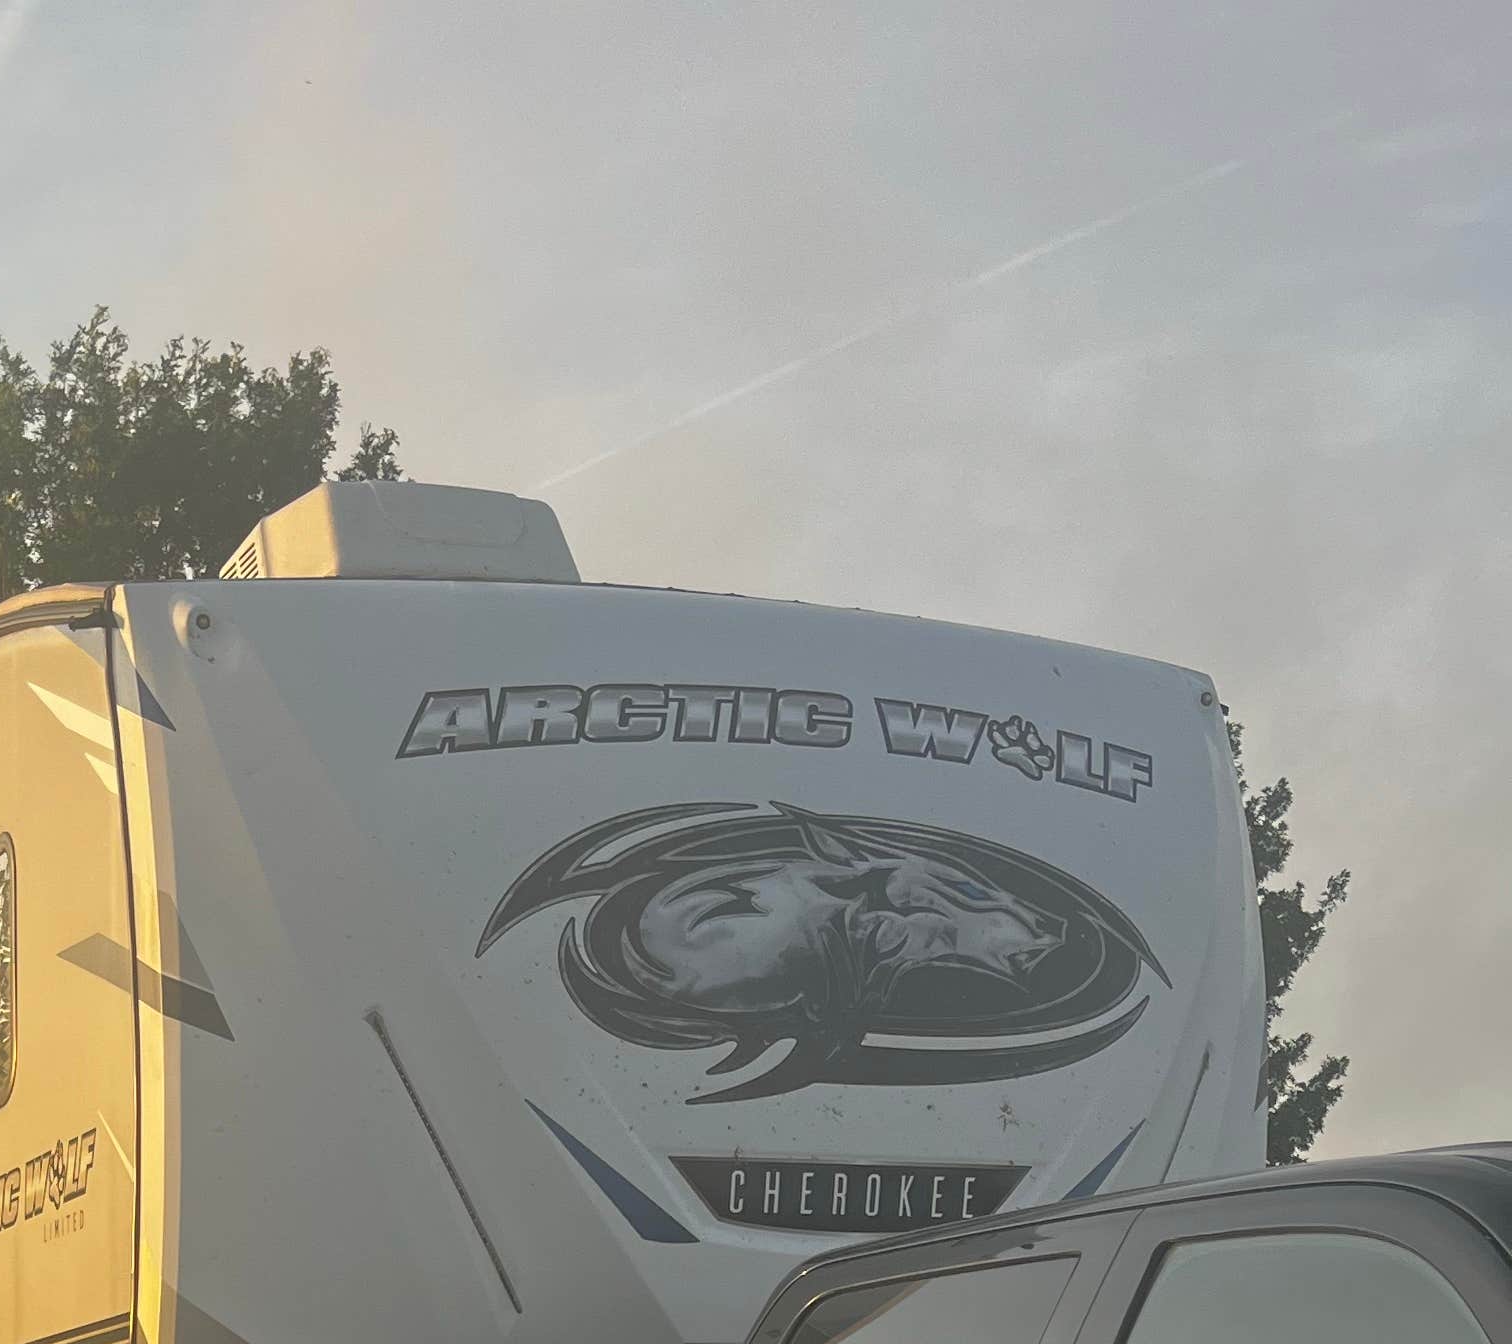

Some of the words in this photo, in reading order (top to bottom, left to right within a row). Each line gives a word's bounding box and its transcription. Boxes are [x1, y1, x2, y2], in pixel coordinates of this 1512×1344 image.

[395, 683, 854, 760] ARCTIC
[729, 1168, 976, 1220] CHEROKEE
[43, 1209, 86, 1243] LIMITED
